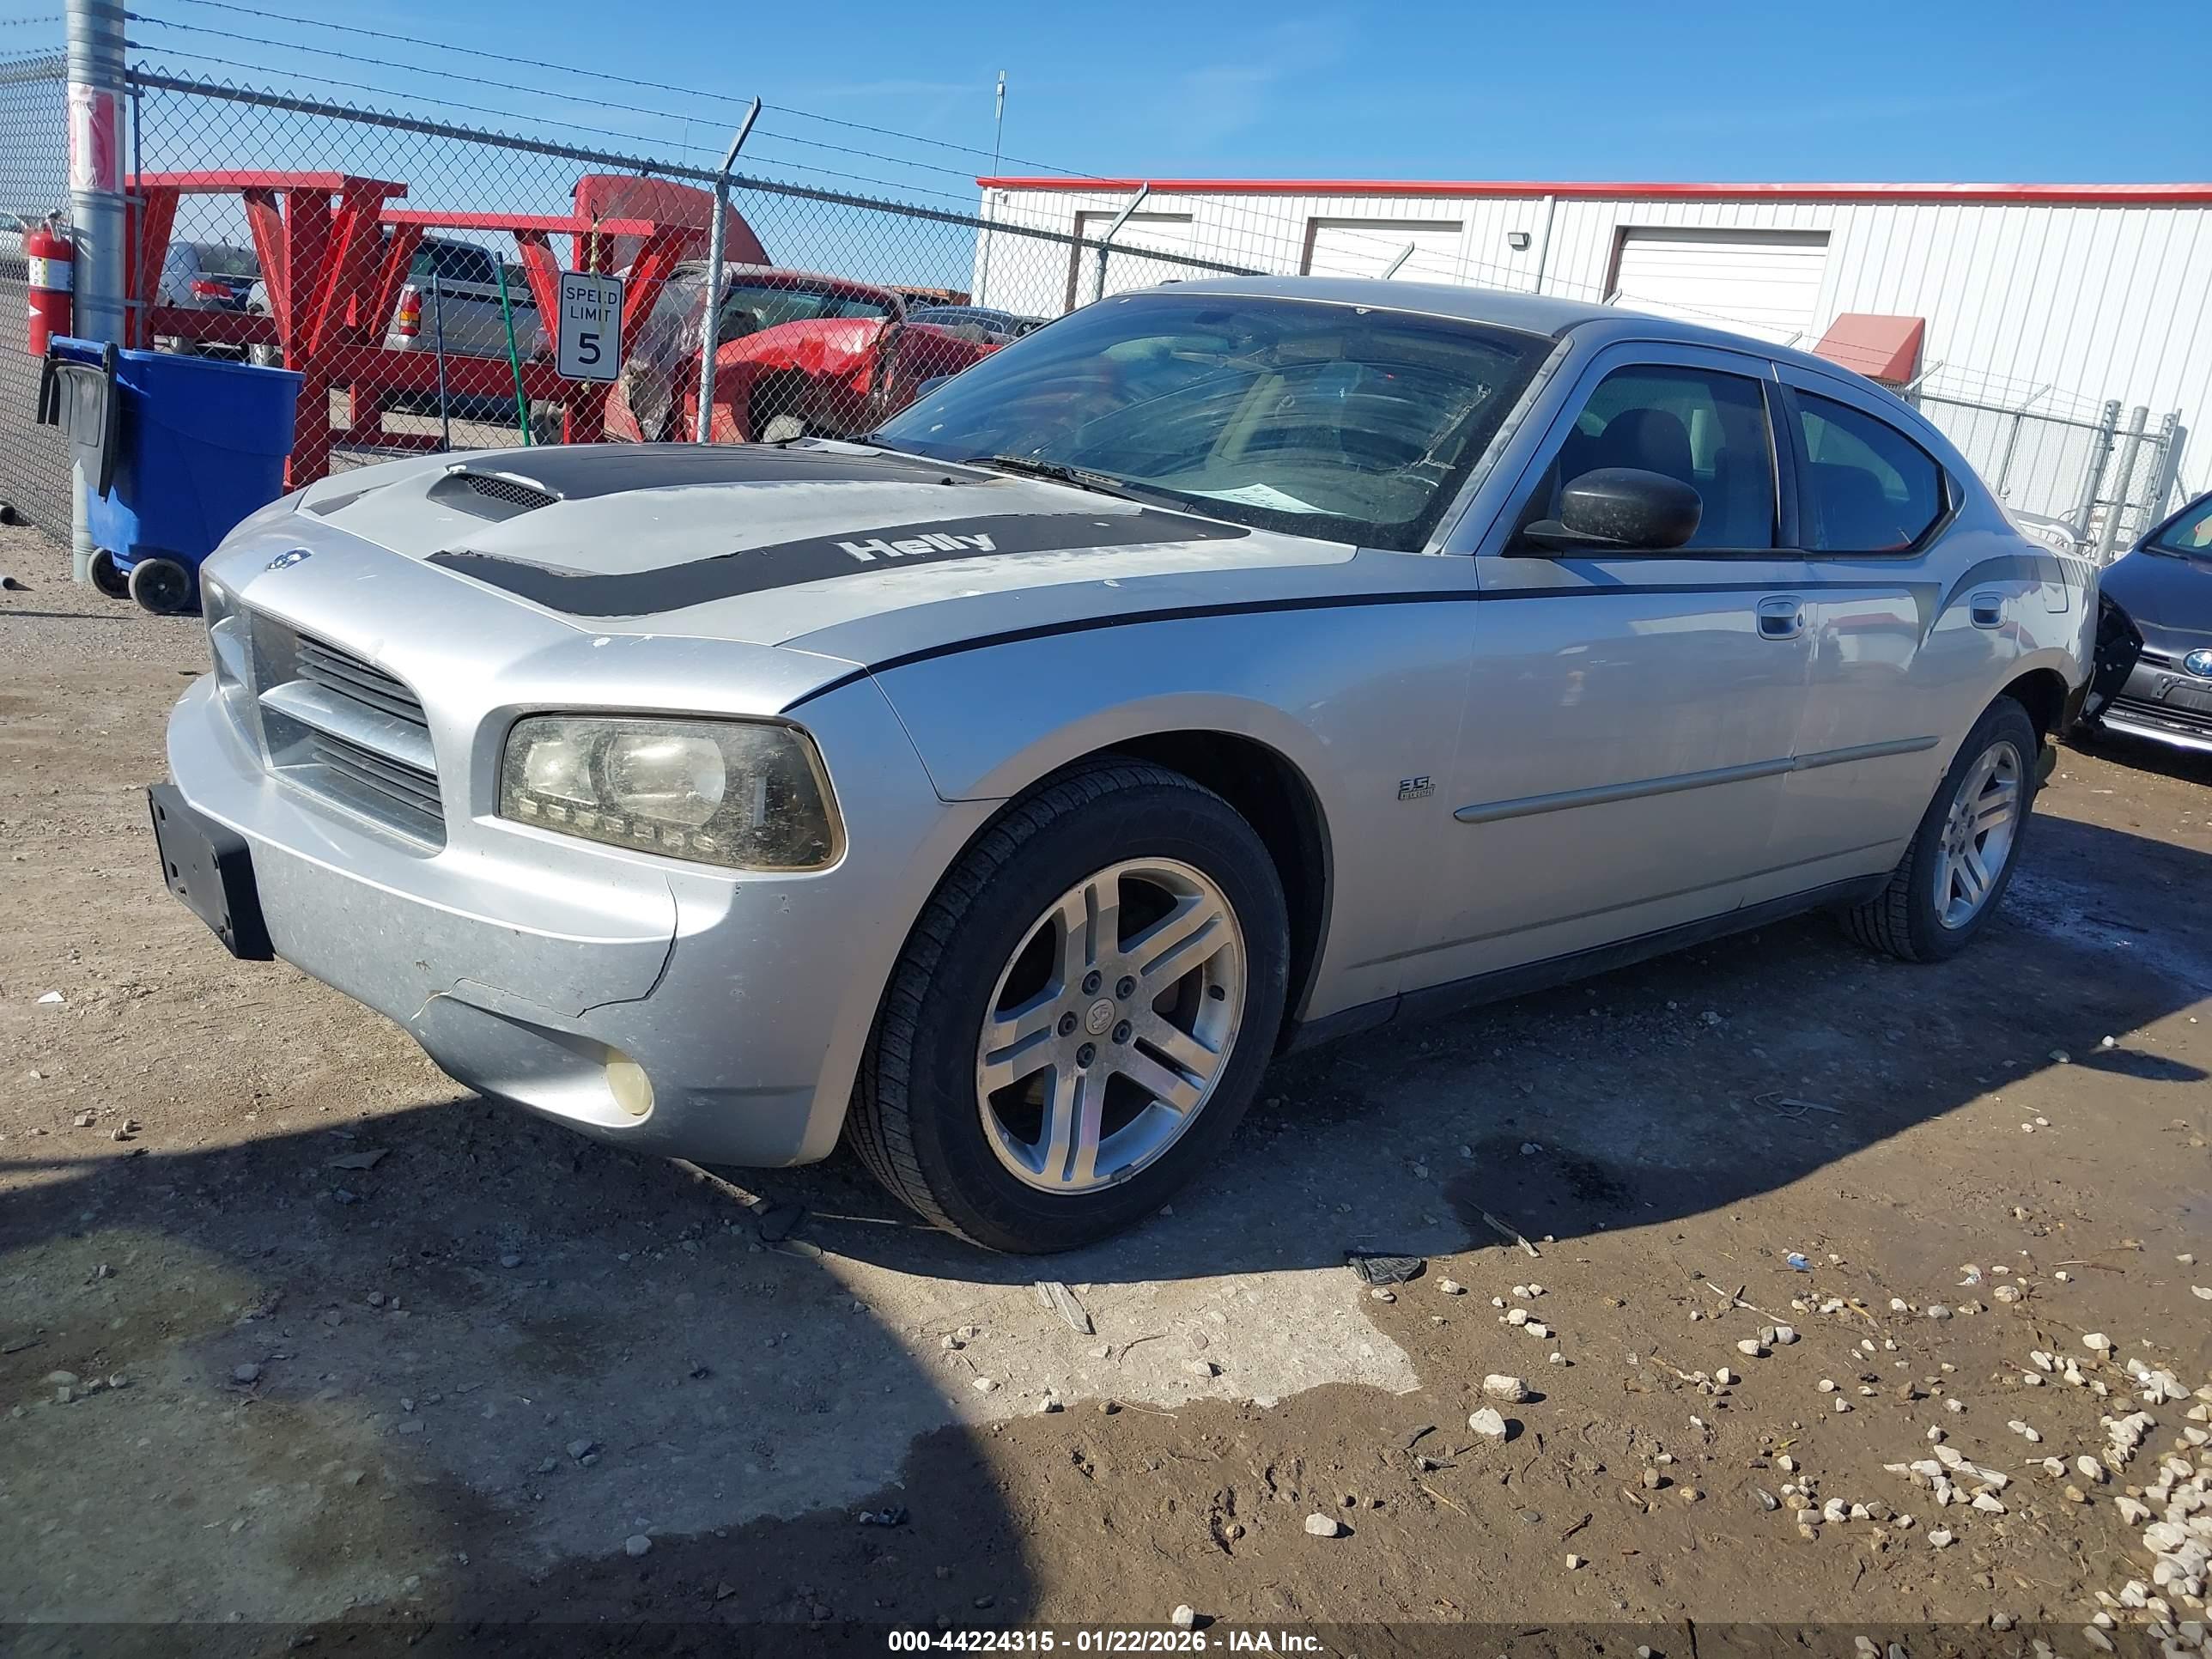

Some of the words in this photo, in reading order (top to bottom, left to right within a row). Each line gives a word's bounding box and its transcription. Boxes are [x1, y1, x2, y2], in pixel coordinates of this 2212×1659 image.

[570, 306, 611, 322] LIMIT
[578, 332, 601, 364] 5
[831, 532, 996, 562] Helly
